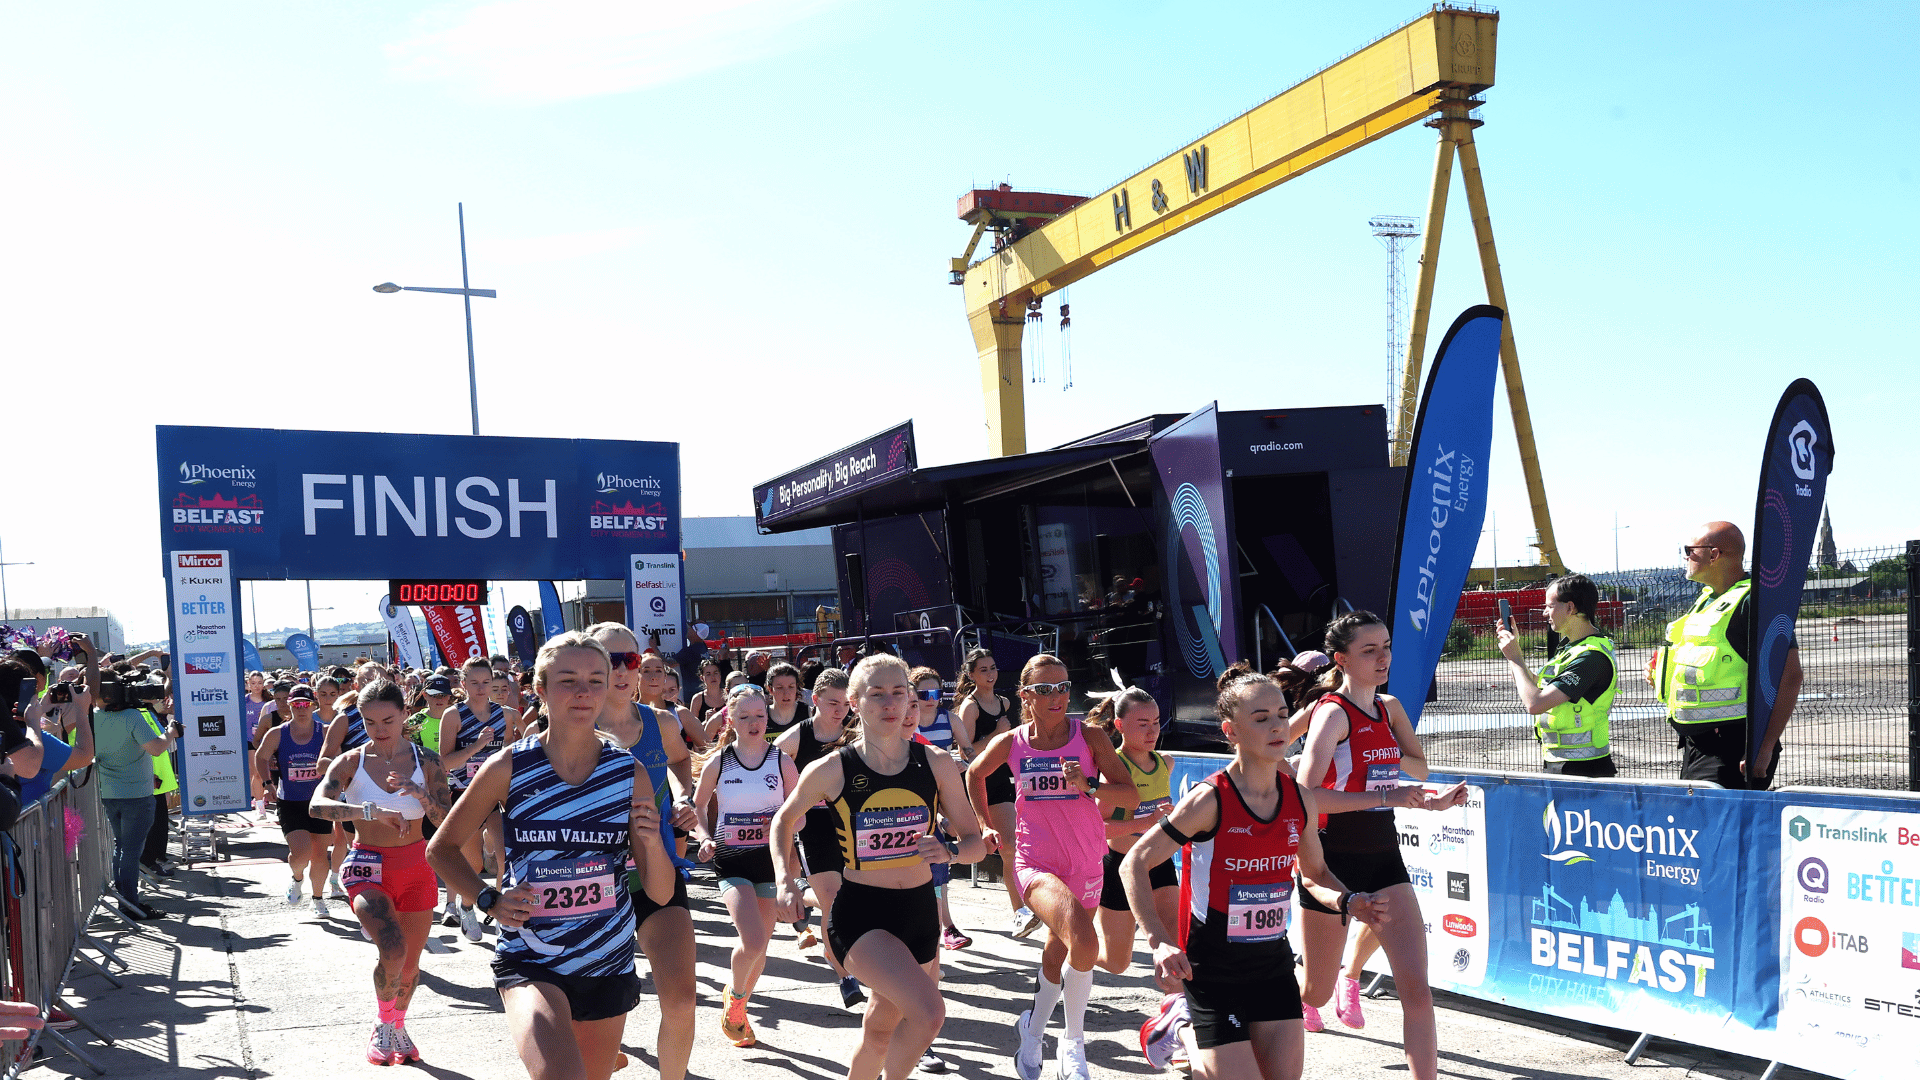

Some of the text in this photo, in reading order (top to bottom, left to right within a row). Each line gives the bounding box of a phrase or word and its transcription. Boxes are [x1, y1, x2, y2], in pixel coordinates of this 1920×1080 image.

[1112, 144, 1205, 231] H & W
[1250, 441, 1303, 454] qradio.com
[191, 464, 256, 479] Phoenix
[779, 484, 791, 506] Big
[835, 461, 849, 485] Big
[849, 448, 877, 477] Reach
[231, 480, 256, 488] Energy
[607, 475, 661, 489] Phoenix
[1453, 453, 1474, 513] Energy
[640, 489, 661, 497] Energy
[1795, 484, 1812, 497] Radio
[302, 473, 558, 539] FINISH
[172, 508, 264, 524] BELFAST
[590, 515, 667, 530] BELFAST
[173, 524, 195, 533] CITY
[1416, 443, 1456, 605] Phoenix
[181, 555, 221, 566] Mirror
[635, 580, 677, 589] BelfastLive
[400, 584, 478, 602] 00:00:00
[182, 602, 225, 615] BETTER
[454, 605, 482, 658] Mirro
[191, 690, 228, 702] Hurst
[294, 769, 317, 778] 1773
[1029, 775, 1067, 791] 1891
[868, 815, 894, 825] Phoenix
[896, 814, 923, 823] BELFAST
[514, 828, 557, 843] LAGAN
[560, 828, 615, 845] VALLEY
[737, 828, 764, 841] 928
[1442, 825, 1475, 836] Marathon
[1564, 809, 1700, 859] Phoenix
[1816, 823, 1888, 844] Translink
[869, 829, 918, 851] 3222
[1397, 831, 1420, 848] nna
[1442, 834, 1465, 844] Photos
[1443, 843, 1456, 852] Live
[540, 866, 572, 875] Phoenix
[575, 863, 607, 875] BELFAST
[1407, 864, 1428, 875] Charles
[1646, 859, 1700, 886] Energy
[1408, 872, 1433, 889] urst
[1450, 879, 1465, 889] MAC
[543, 883, 602, 910] 2323
[1242, 890, 1268, 899] Phoenix
[1803, 894, 1825, 904] Radio
[1243, 907, 1284, 930] 1989
[1445, 919, 1474, 932] Linwoods
[1832, 931, 1869, 954] iTAB
[1531, 927, 1715, 998] BELFAST
[1528, 973, 1564, 997] CITY
[1810, 989, 1852, 1004] ATHLETICS
